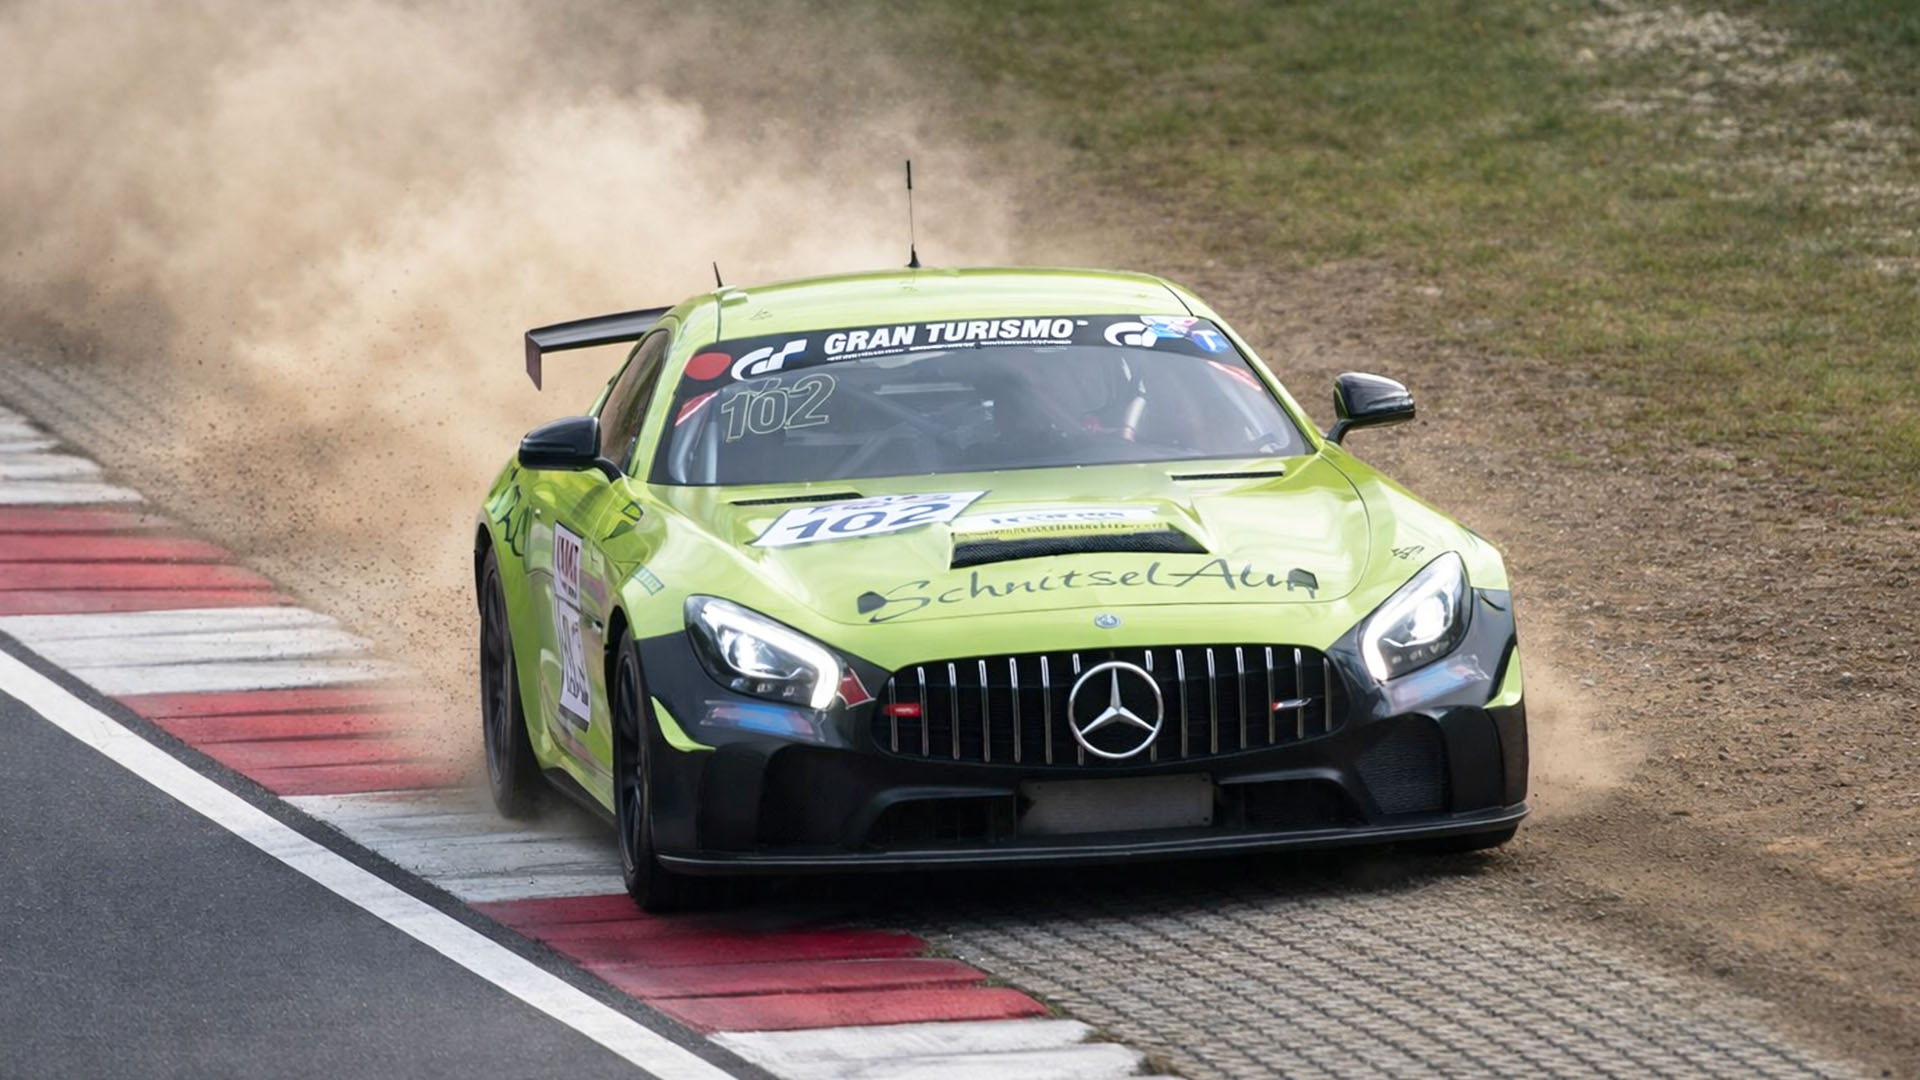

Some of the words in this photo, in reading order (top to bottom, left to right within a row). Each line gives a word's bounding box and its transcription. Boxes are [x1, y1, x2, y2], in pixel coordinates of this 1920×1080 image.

[823, 325, 917, 355] GRAN
[926, 318, 1076, 343] TURISMO
[720, 372, 837, 443] 102
[786, 502, 951, 540] 102
